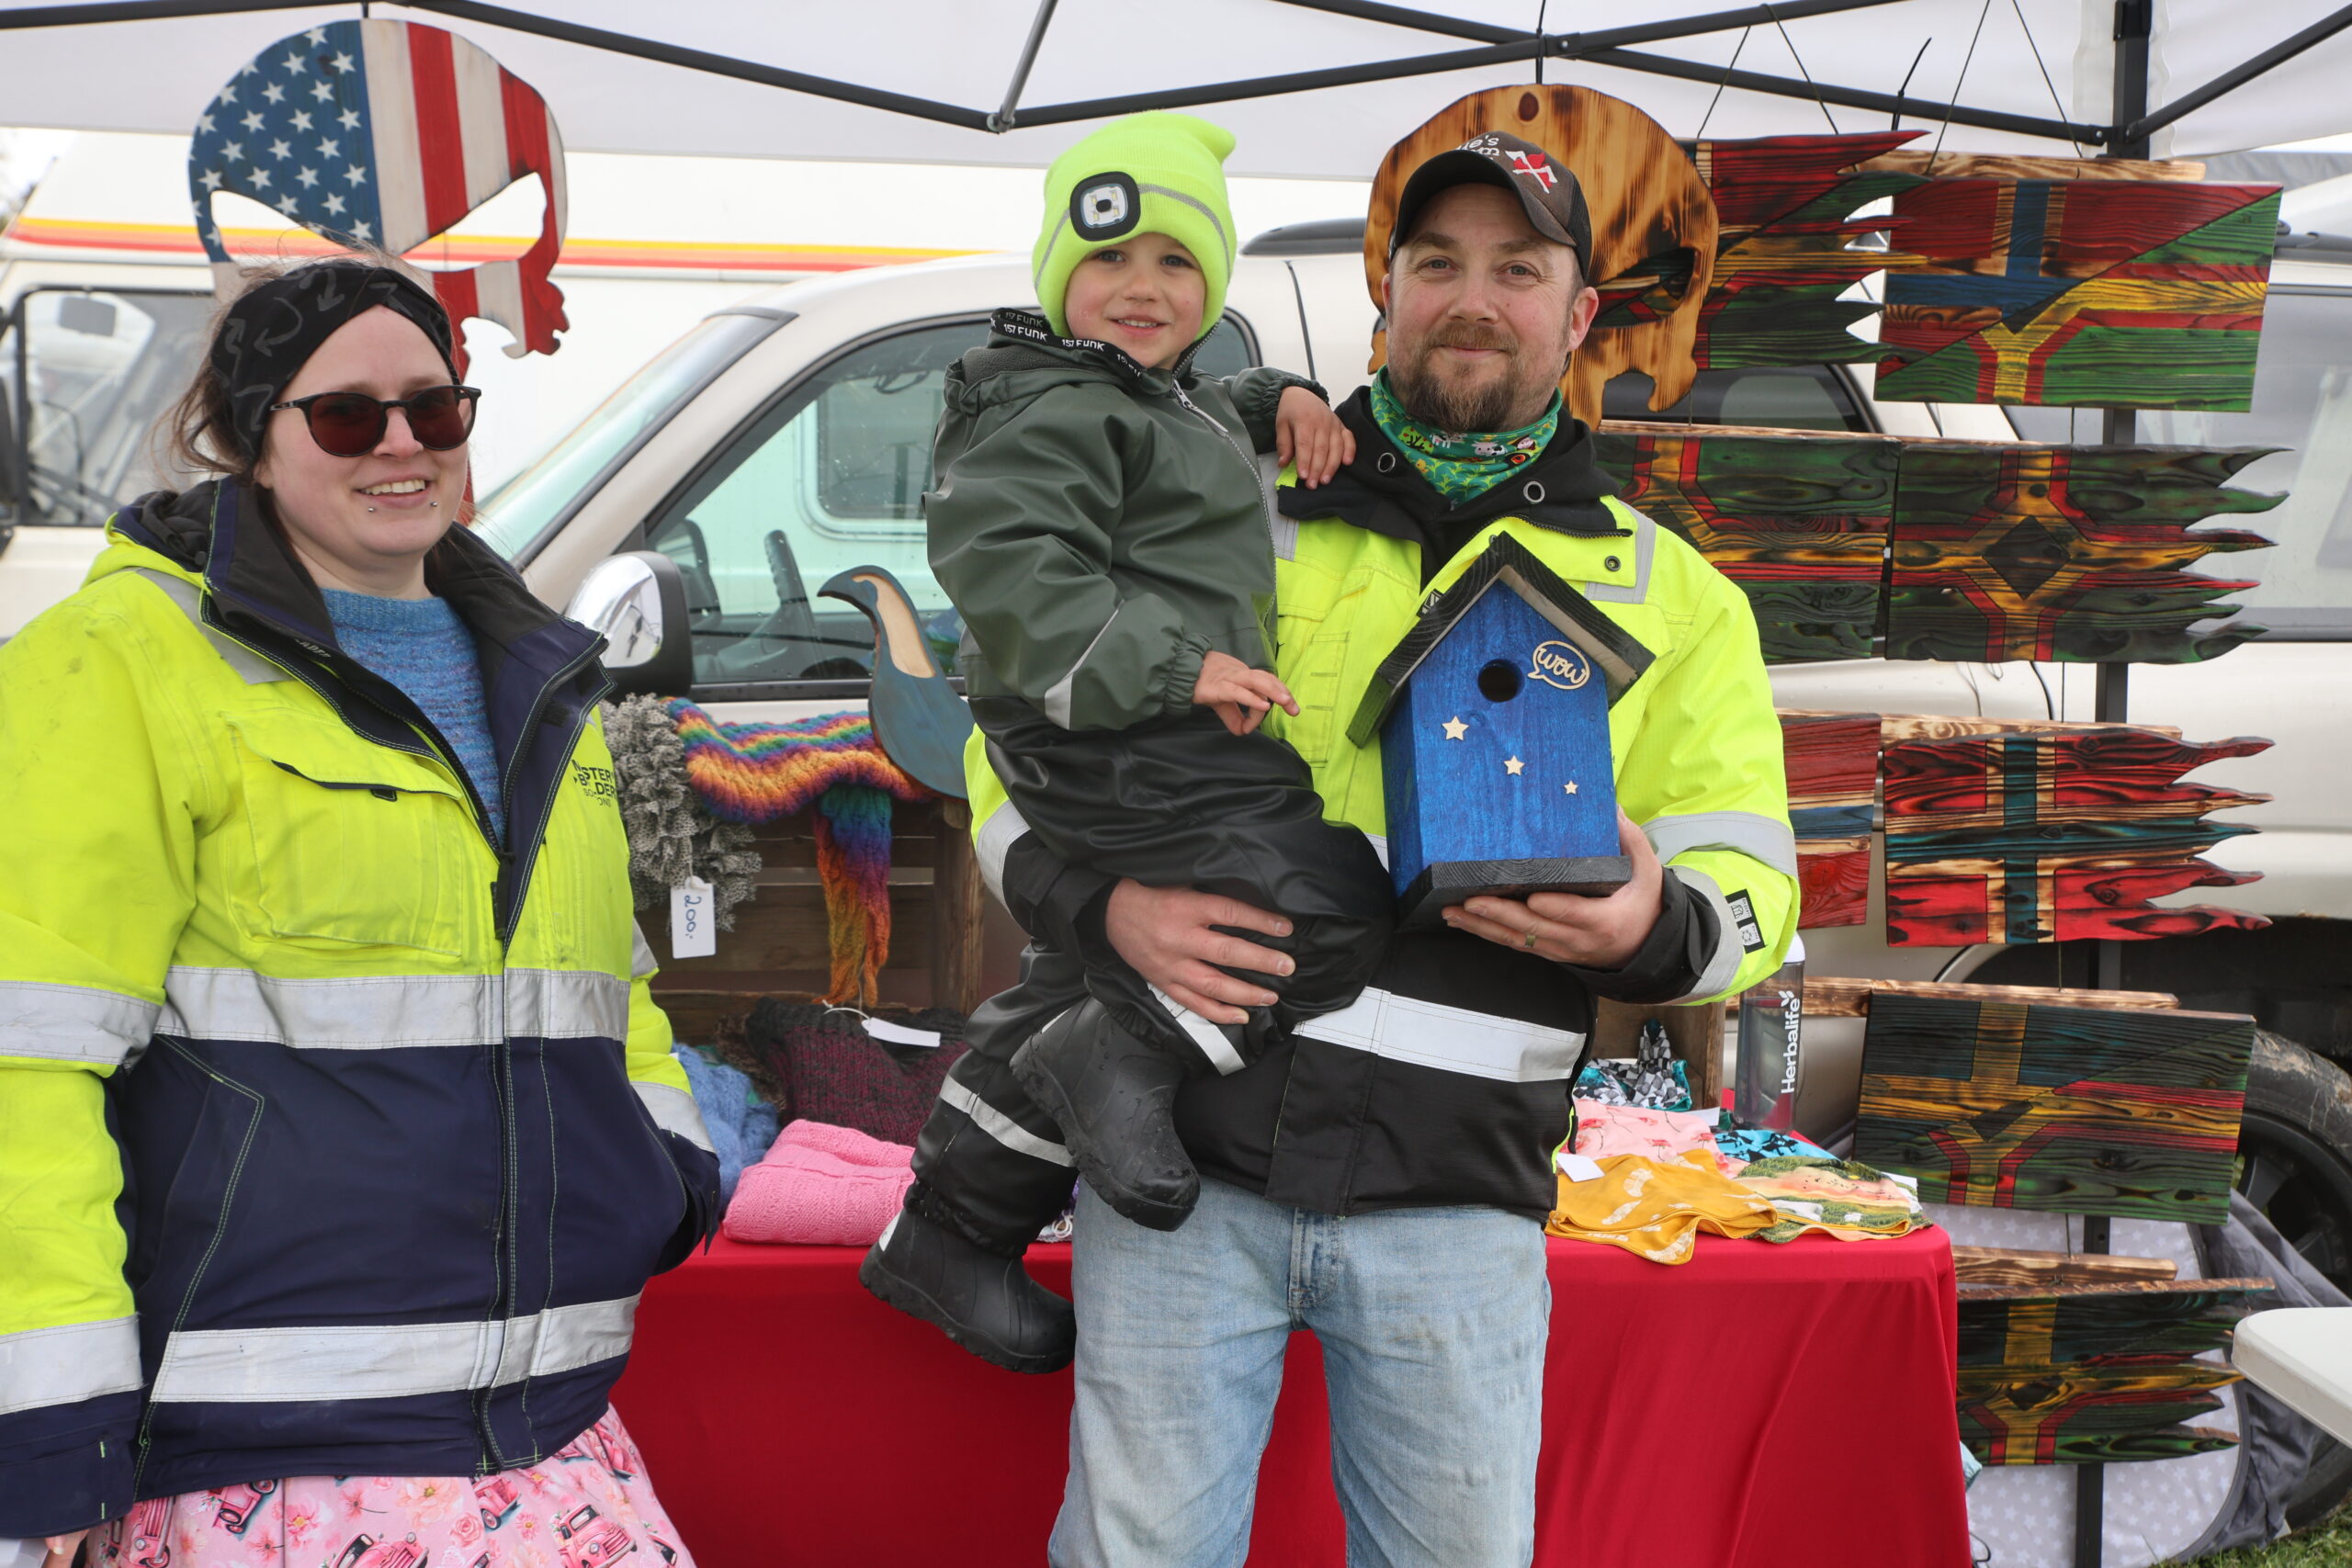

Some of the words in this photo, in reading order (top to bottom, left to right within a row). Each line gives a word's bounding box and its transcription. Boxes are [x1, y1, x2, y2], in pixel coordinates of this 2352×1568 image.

[1003, 323, 1016, 334] 157
[1017, 326, 1048, 342] FUNK
[1061, 339, 1075, 347] 157
[1076, 339, 1105, 352] FUNK
[1781, 998, 1801, 1094] Herbalife
